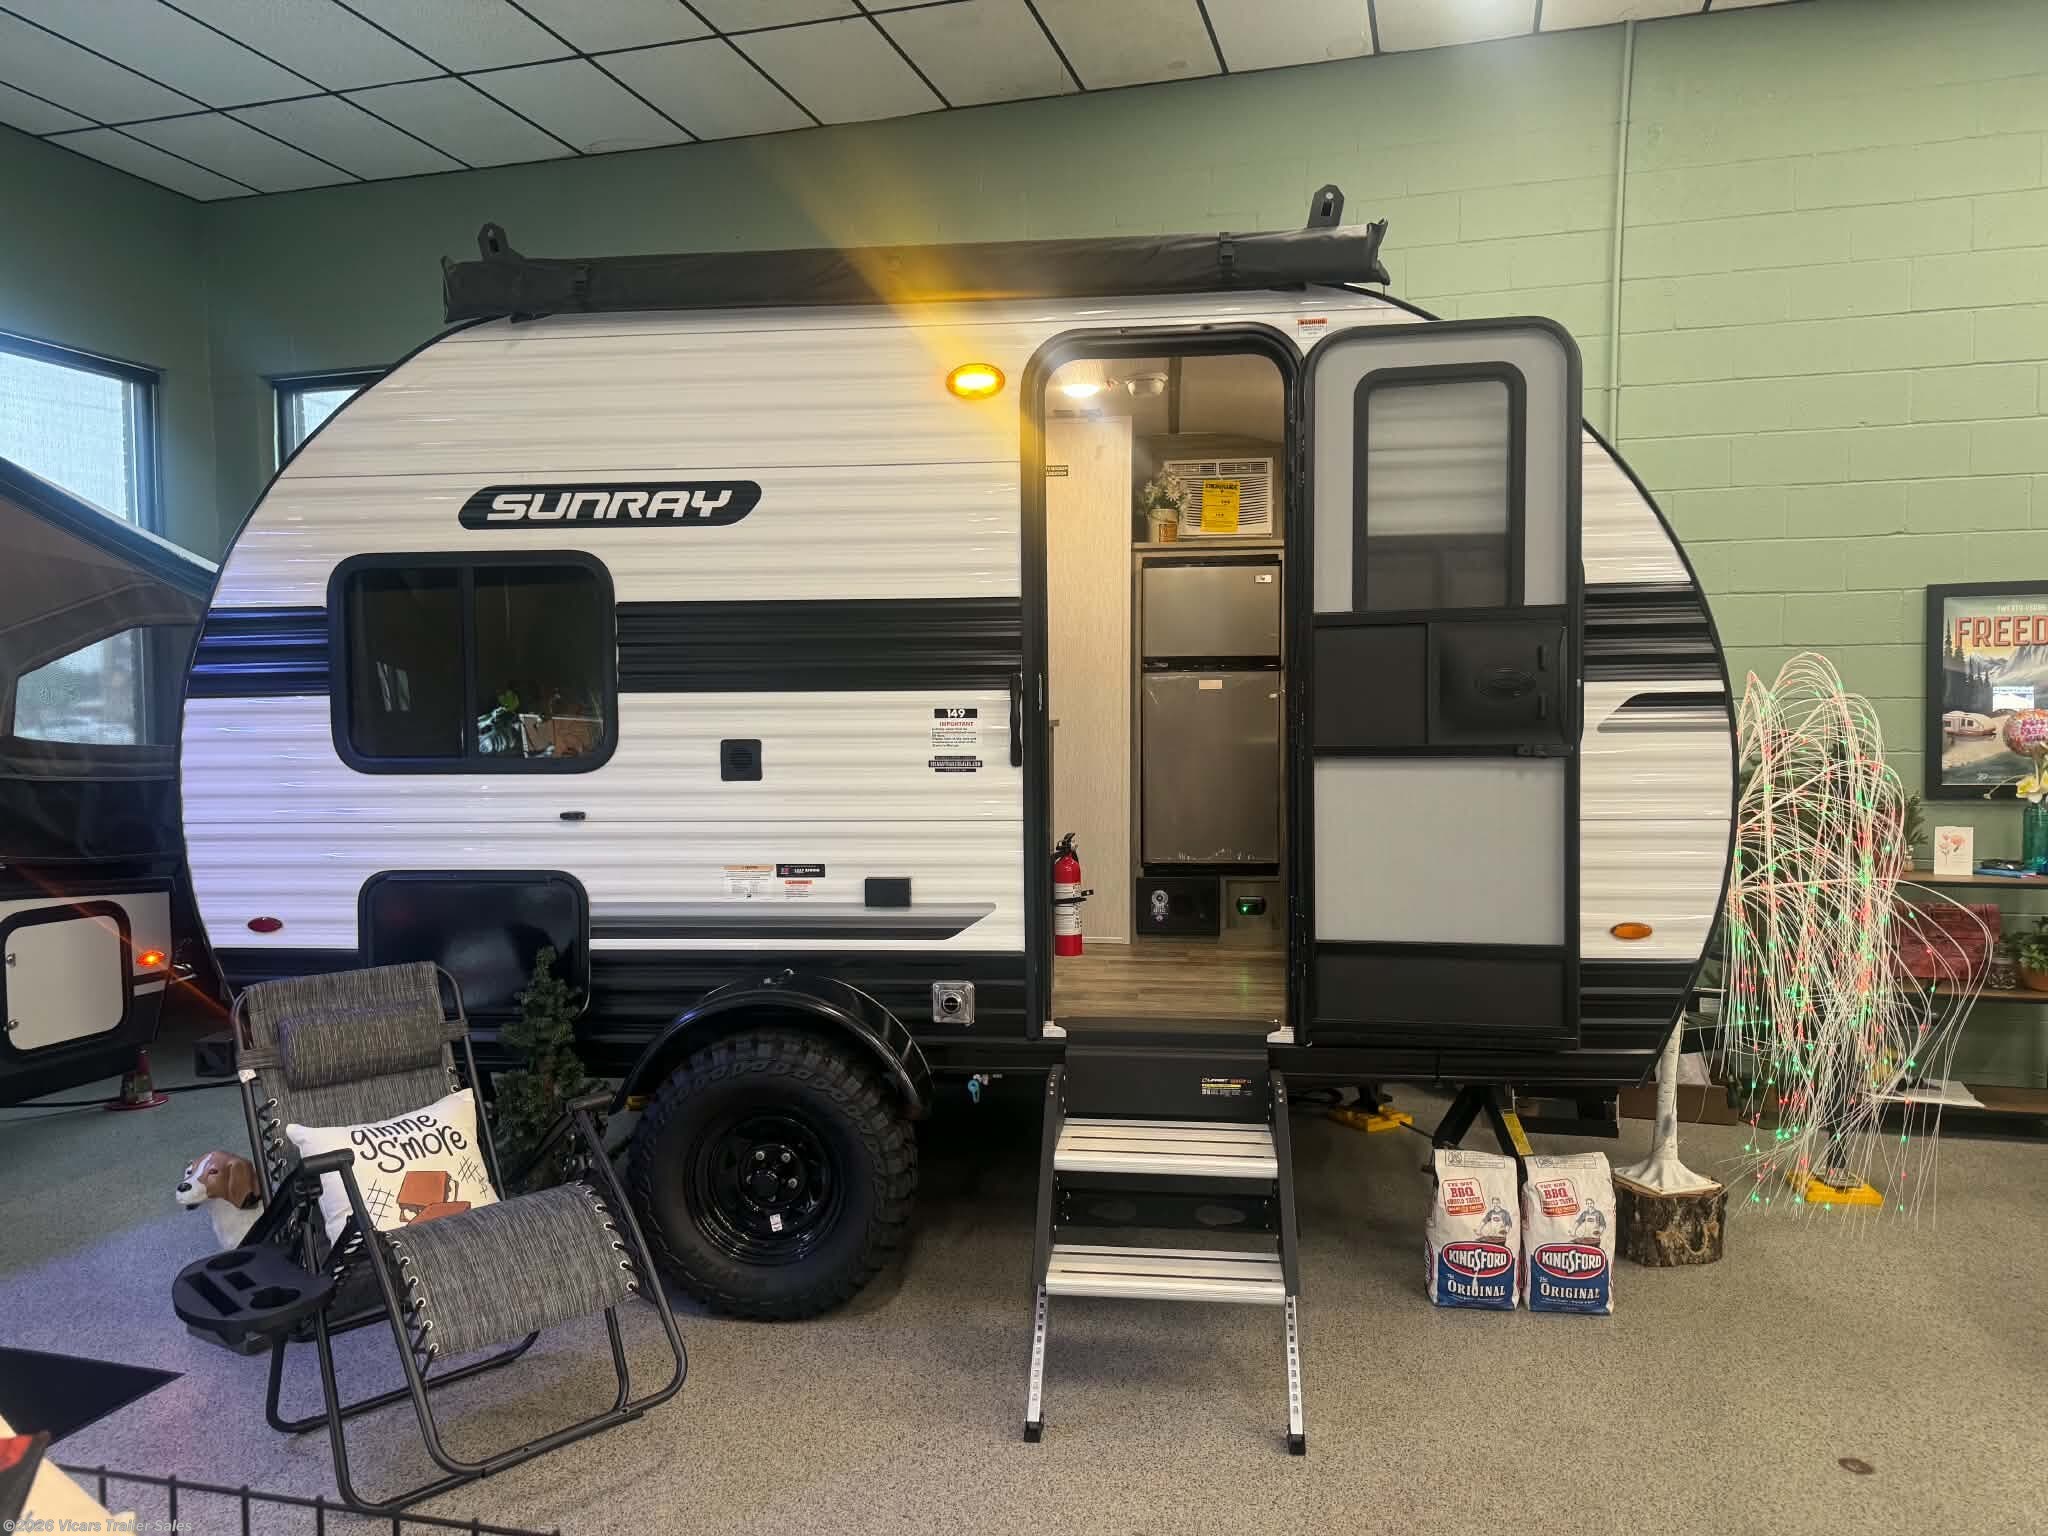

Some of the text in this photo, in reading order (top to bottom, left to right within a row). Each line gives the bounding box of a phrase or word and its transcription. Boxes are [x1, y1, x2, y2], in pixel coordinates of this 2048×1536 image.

[487, 490, 732, 520] SUNRAY
[946, 709, 966, 718] 149
[351, 1115, 437, 1160] gimme
[1450, 1187, 1475, 1198] BBQ
[1543, 1188, 1568, 1199] BBQ
[1448, 1248, 1507, 1272] KINGSFORD
[1542, 1249, 1602, 1273] KINGSFORD
[1540, 1282, 1600, 1298] ORIGINAL
